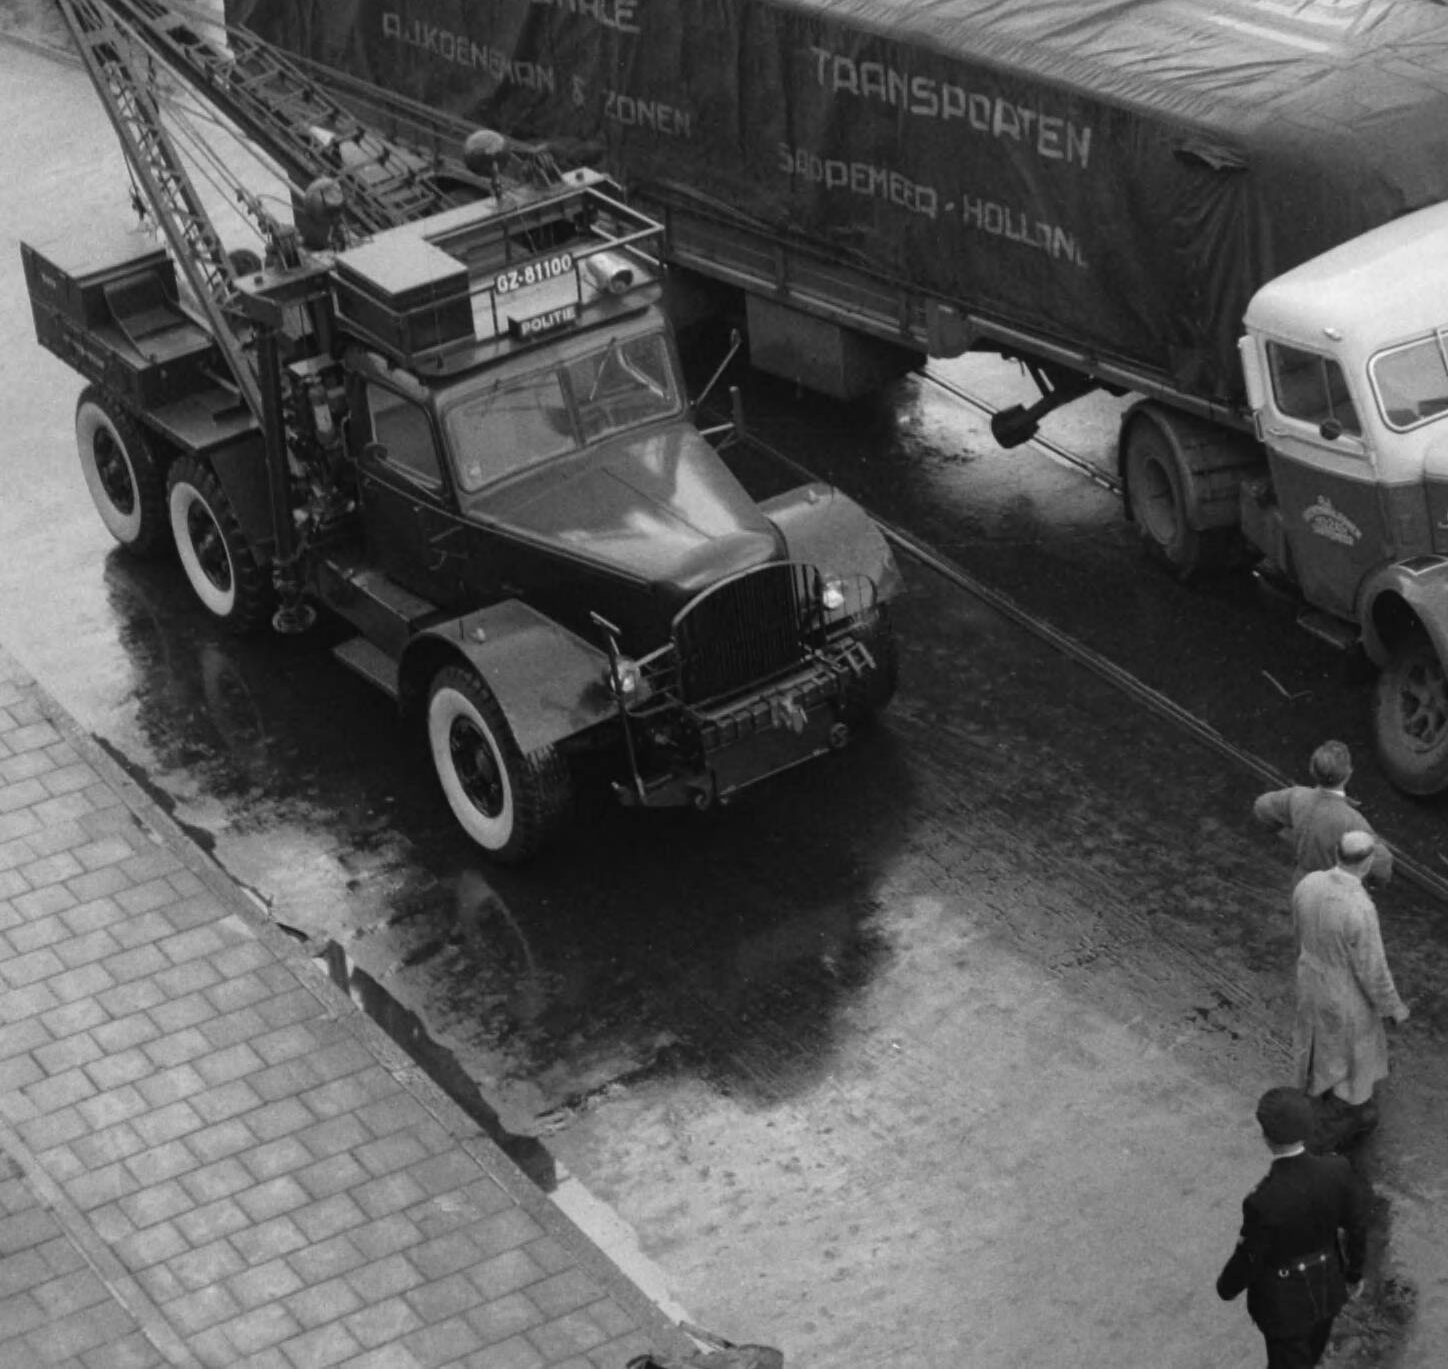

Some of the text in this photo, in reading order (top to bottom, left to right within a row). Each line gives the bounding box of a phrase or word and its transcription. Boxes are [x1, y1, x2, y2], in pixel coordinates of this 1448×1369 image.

[603, 89, 691, 138] ZONEN
[810, 45, 1092, 169] TRANSPORTEN
[521, 306, 577, 336] POLITIE
